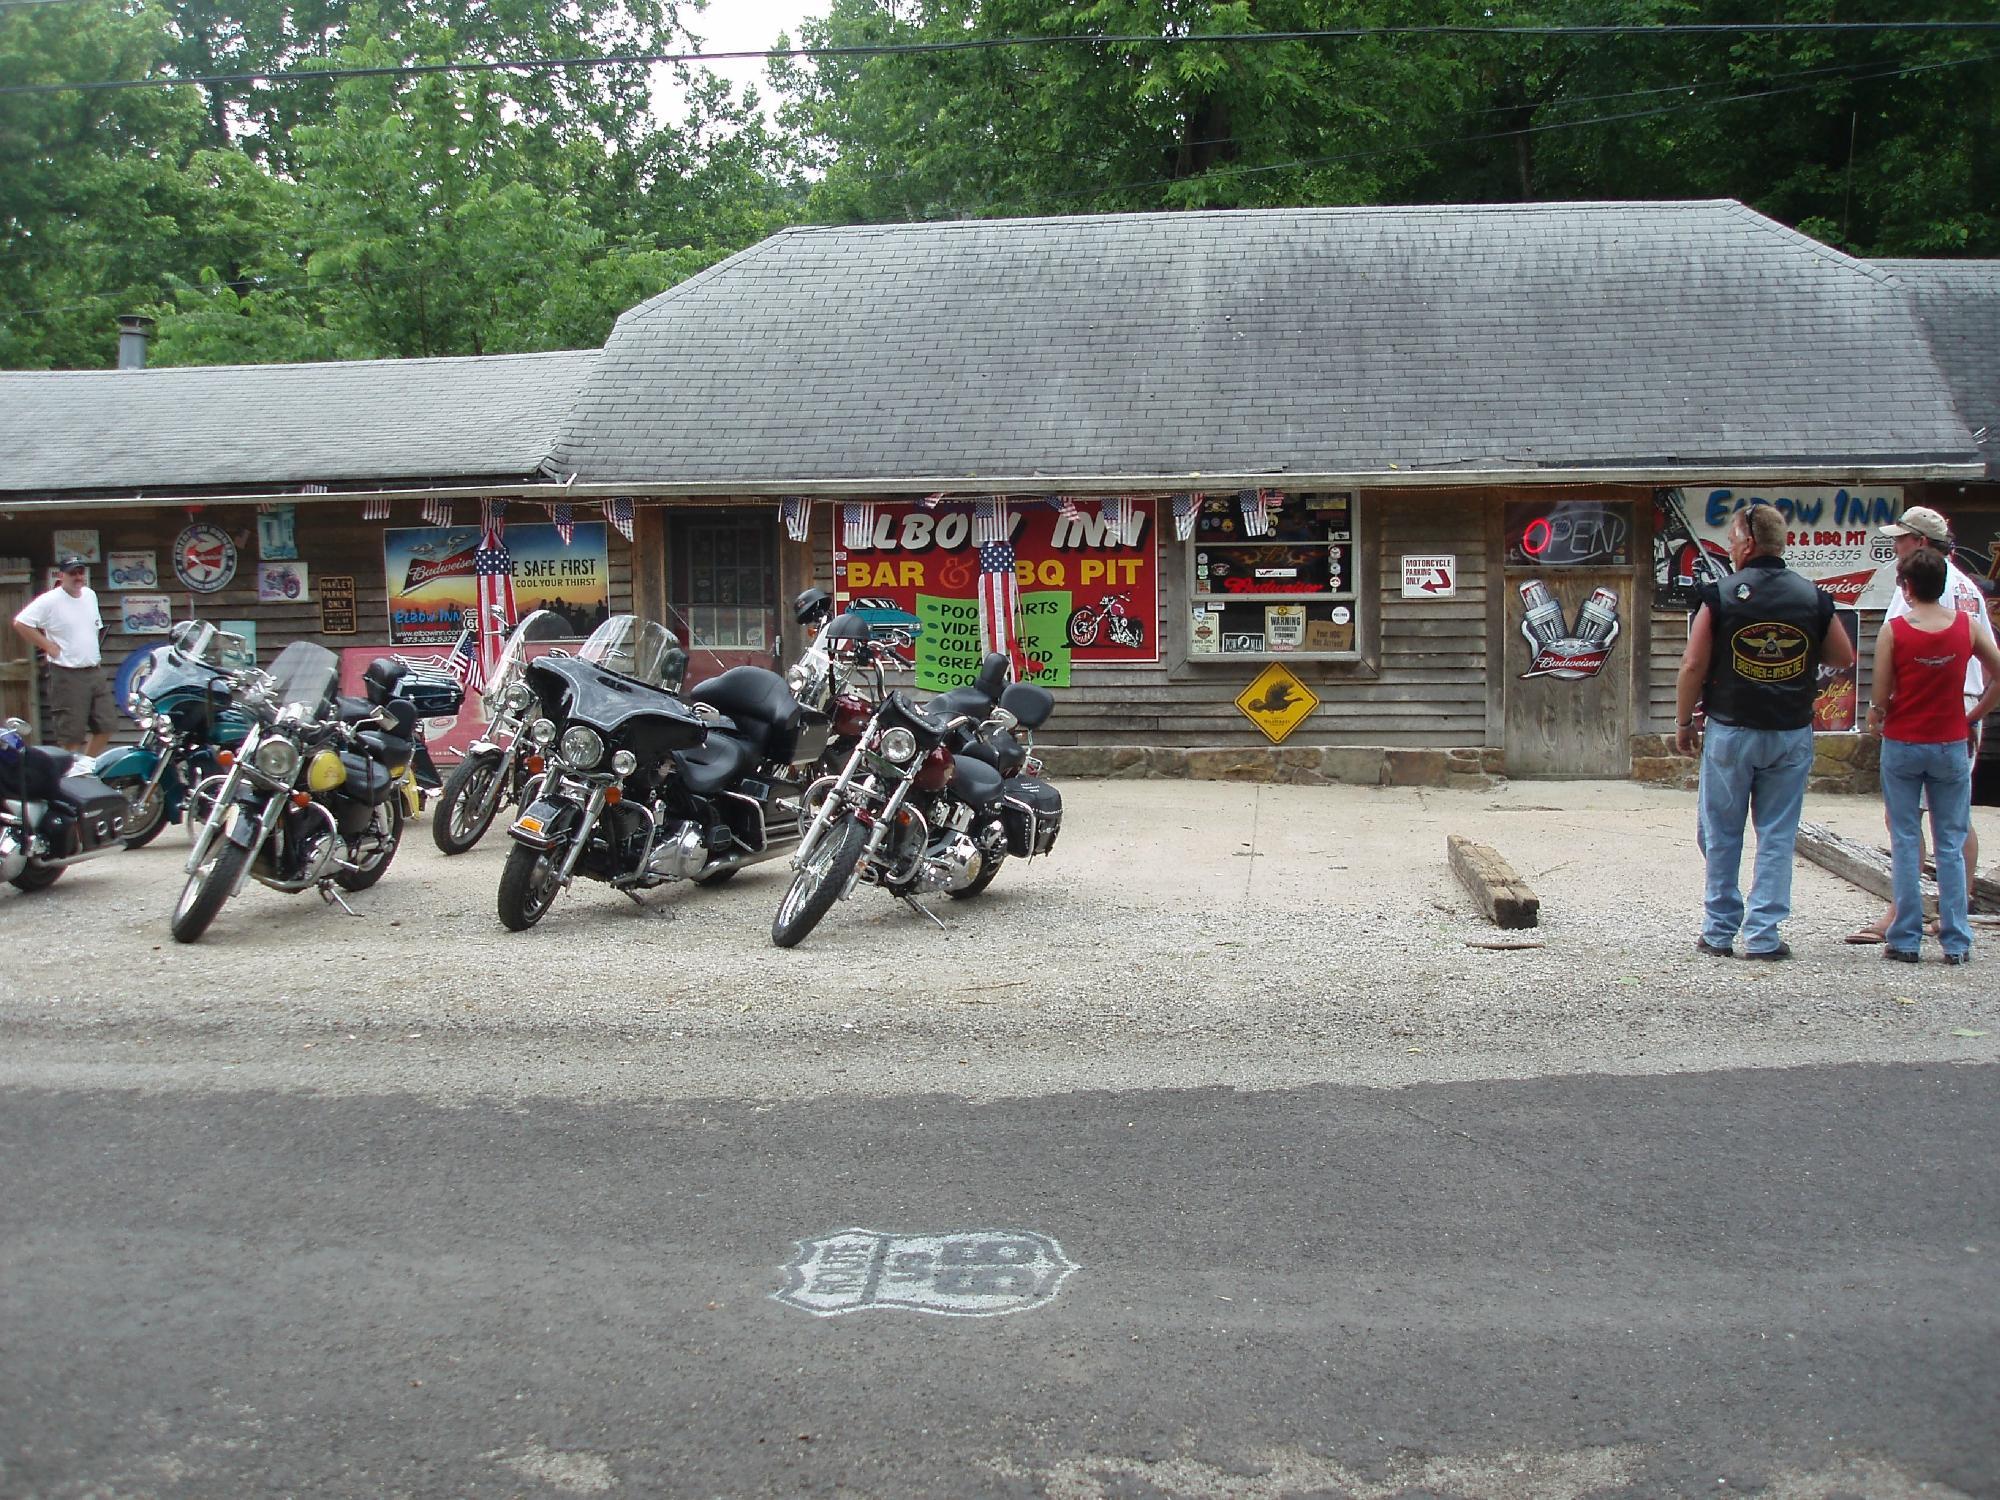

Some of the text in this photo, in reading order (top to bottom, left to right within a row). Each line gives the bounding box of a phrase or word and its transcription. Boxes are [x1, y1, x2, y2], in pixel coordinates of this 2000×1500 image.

[1705, 489, 1896, 526] EOW INN
[846, 510, 1146, 550] LBO INN
[1523, 517, 1617, 554] OPEN
[1813, 531, 1842, 547] BBQ
[1845, 530, 1867, 546] PIT
[1782, 550, 1861, 561] 3-336-5375
[1874, 548, 1893, 559] 66
[408, 558, 476, 582] Budweiser
[524, 560, 555, 577] SAFE
[561, 558, 596, 576] FIRST
[1406, 559, 1452, 567] MOTORCYCLE
[1784, 560, 1854, 568] w.elbowinn.com
[848, 560, 925, 588] BAR
[1014, 559, 1065, 586] BQ
[1080, 559, 1144, 585] PIT
[1406, 568, 1431, 576] PARKING
[516, 578, 596, 588] COOL YOUR THIRST
[1406, 577, 1420, 585] ONLY
[1817, 578, 1875, 593] weiser
[328, 600, 347, 609] ONLY
[941, 601, 1059, 619] POO ARTS
[438, 607, 461, 623] INN
[1270, 616, 1301, 626] WARNING
[396, 630, 463, 638] www.elbowinn.com
[402, 636, 458, 644] 573-336-5375
[939, 635, 1040, 653] COLD ER
[938, 655, 984, 671] GREA
[1536, 656, 1602, 669] Budweiser
[937, 668, 1058, 686] GOO SIC!
